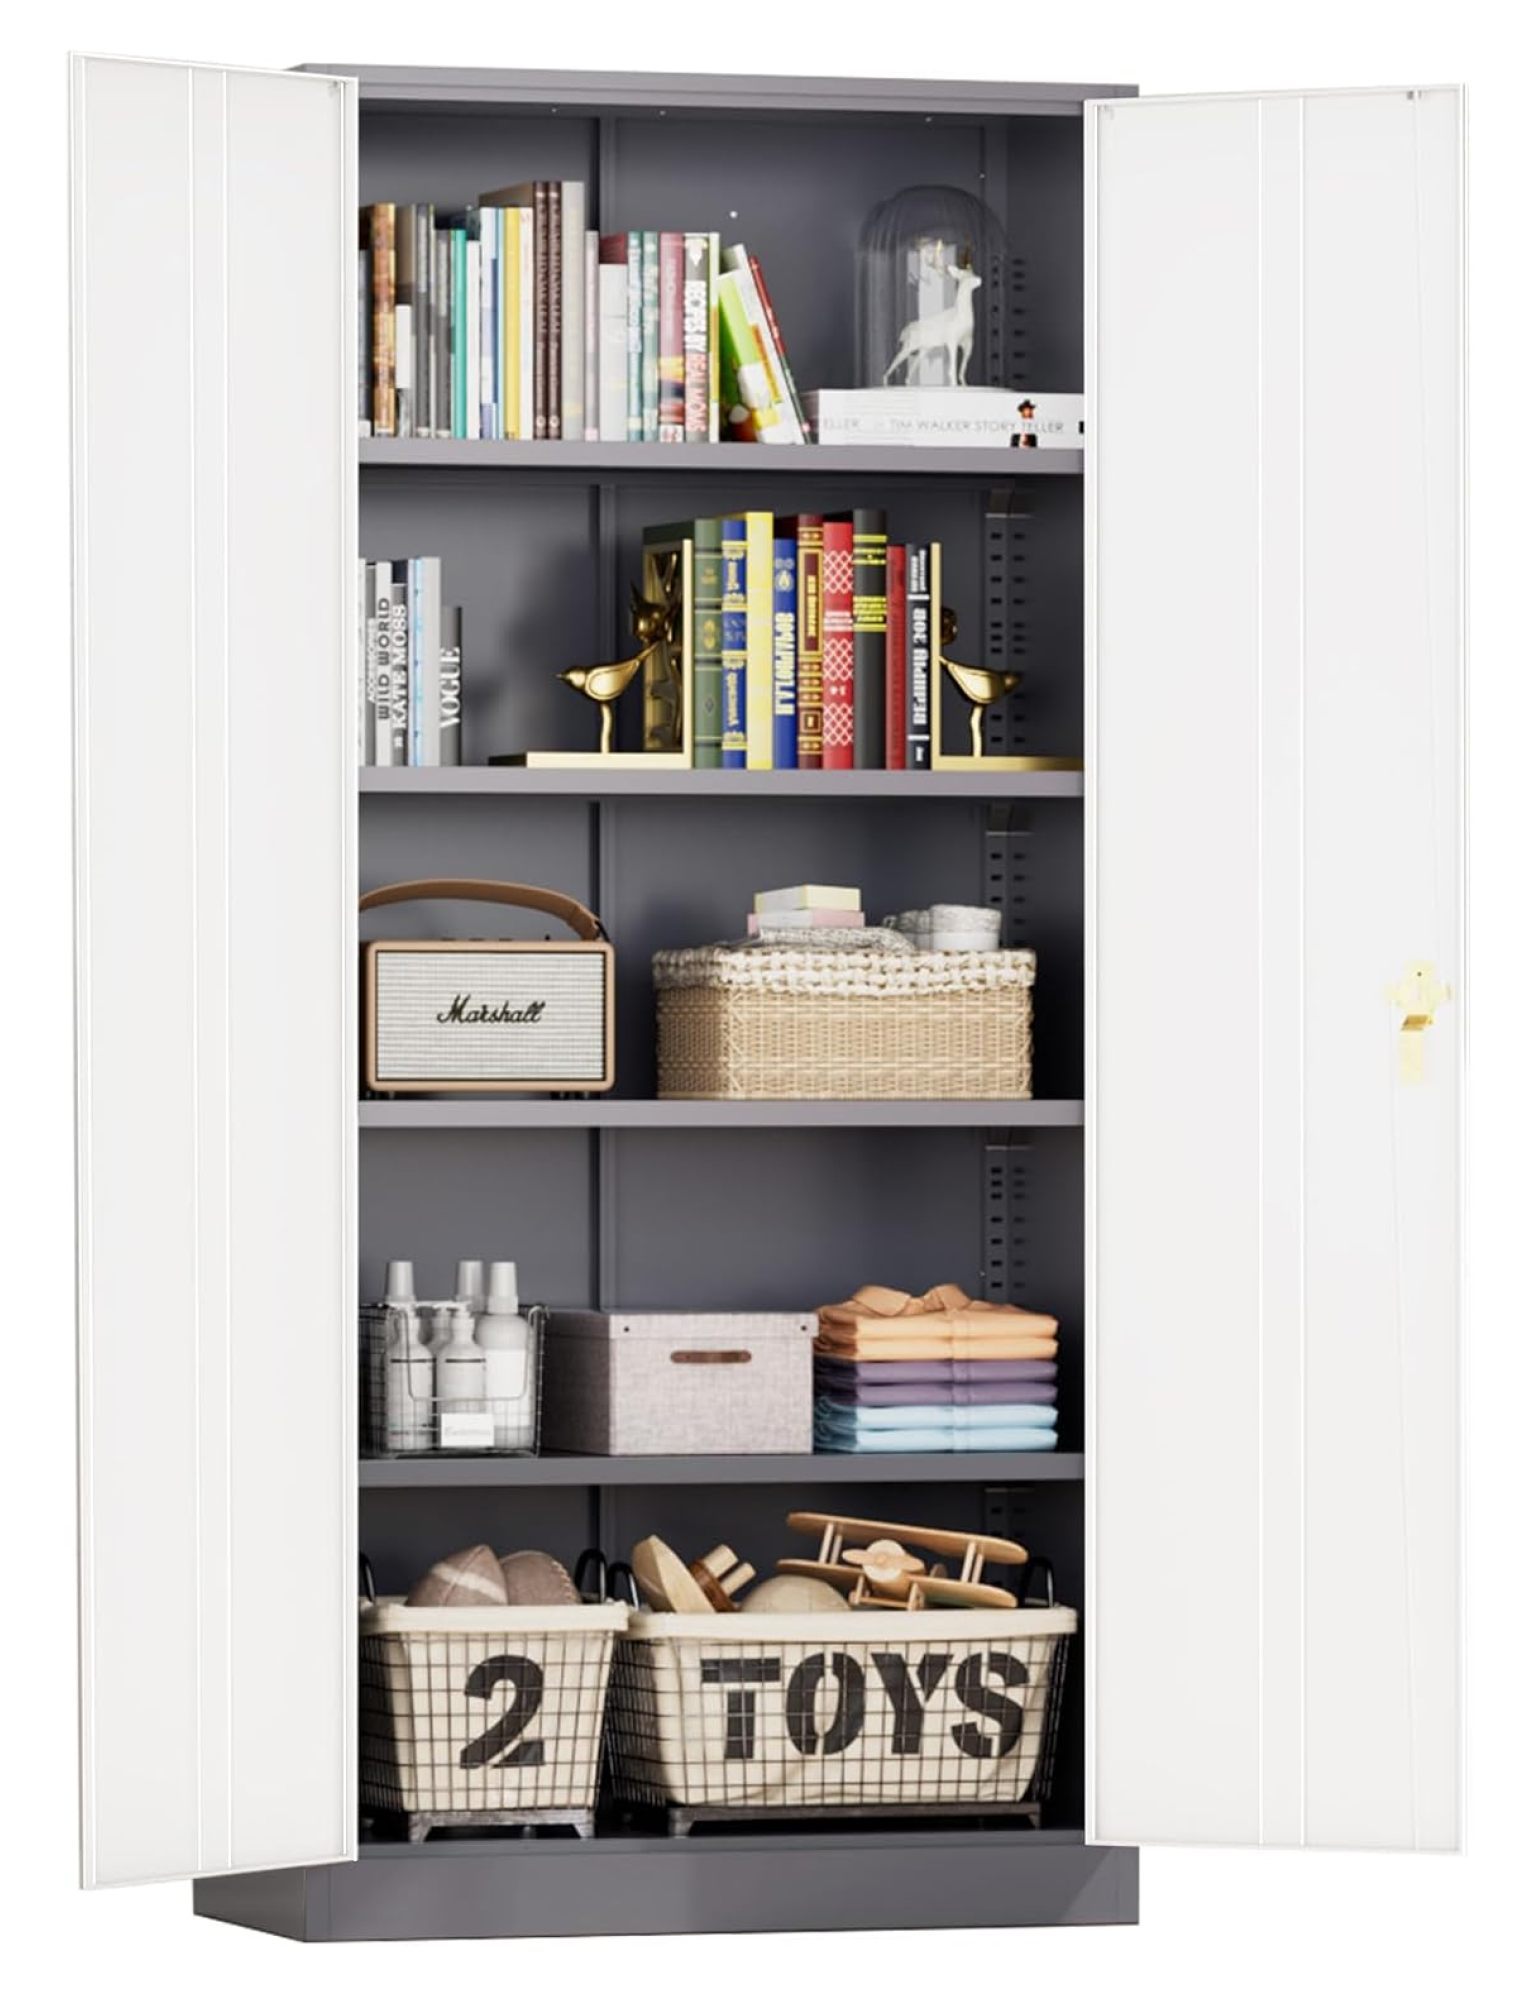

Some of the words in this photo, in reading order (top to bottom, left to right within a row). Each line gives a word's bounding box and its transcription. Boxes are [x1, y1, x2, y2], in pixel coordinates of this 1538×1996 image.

[685, 334, 706, 351] BY
[685, 353, 706, 387] REAL
[889, 418, 912, 431] TIM
[916, 419, 971, 432] WALKER
[975, 420, 1016, 433] STORY
[391, 604, 407, 666] MOSS
[391, 669, 407, 729] KATE
[439, 647, 461, 729] VOGUE
[436, 993, 546, 1023] Marshall
[459, 1654, 546, 1769] 2
[700, 1650, 1031, 1760] TOYS
